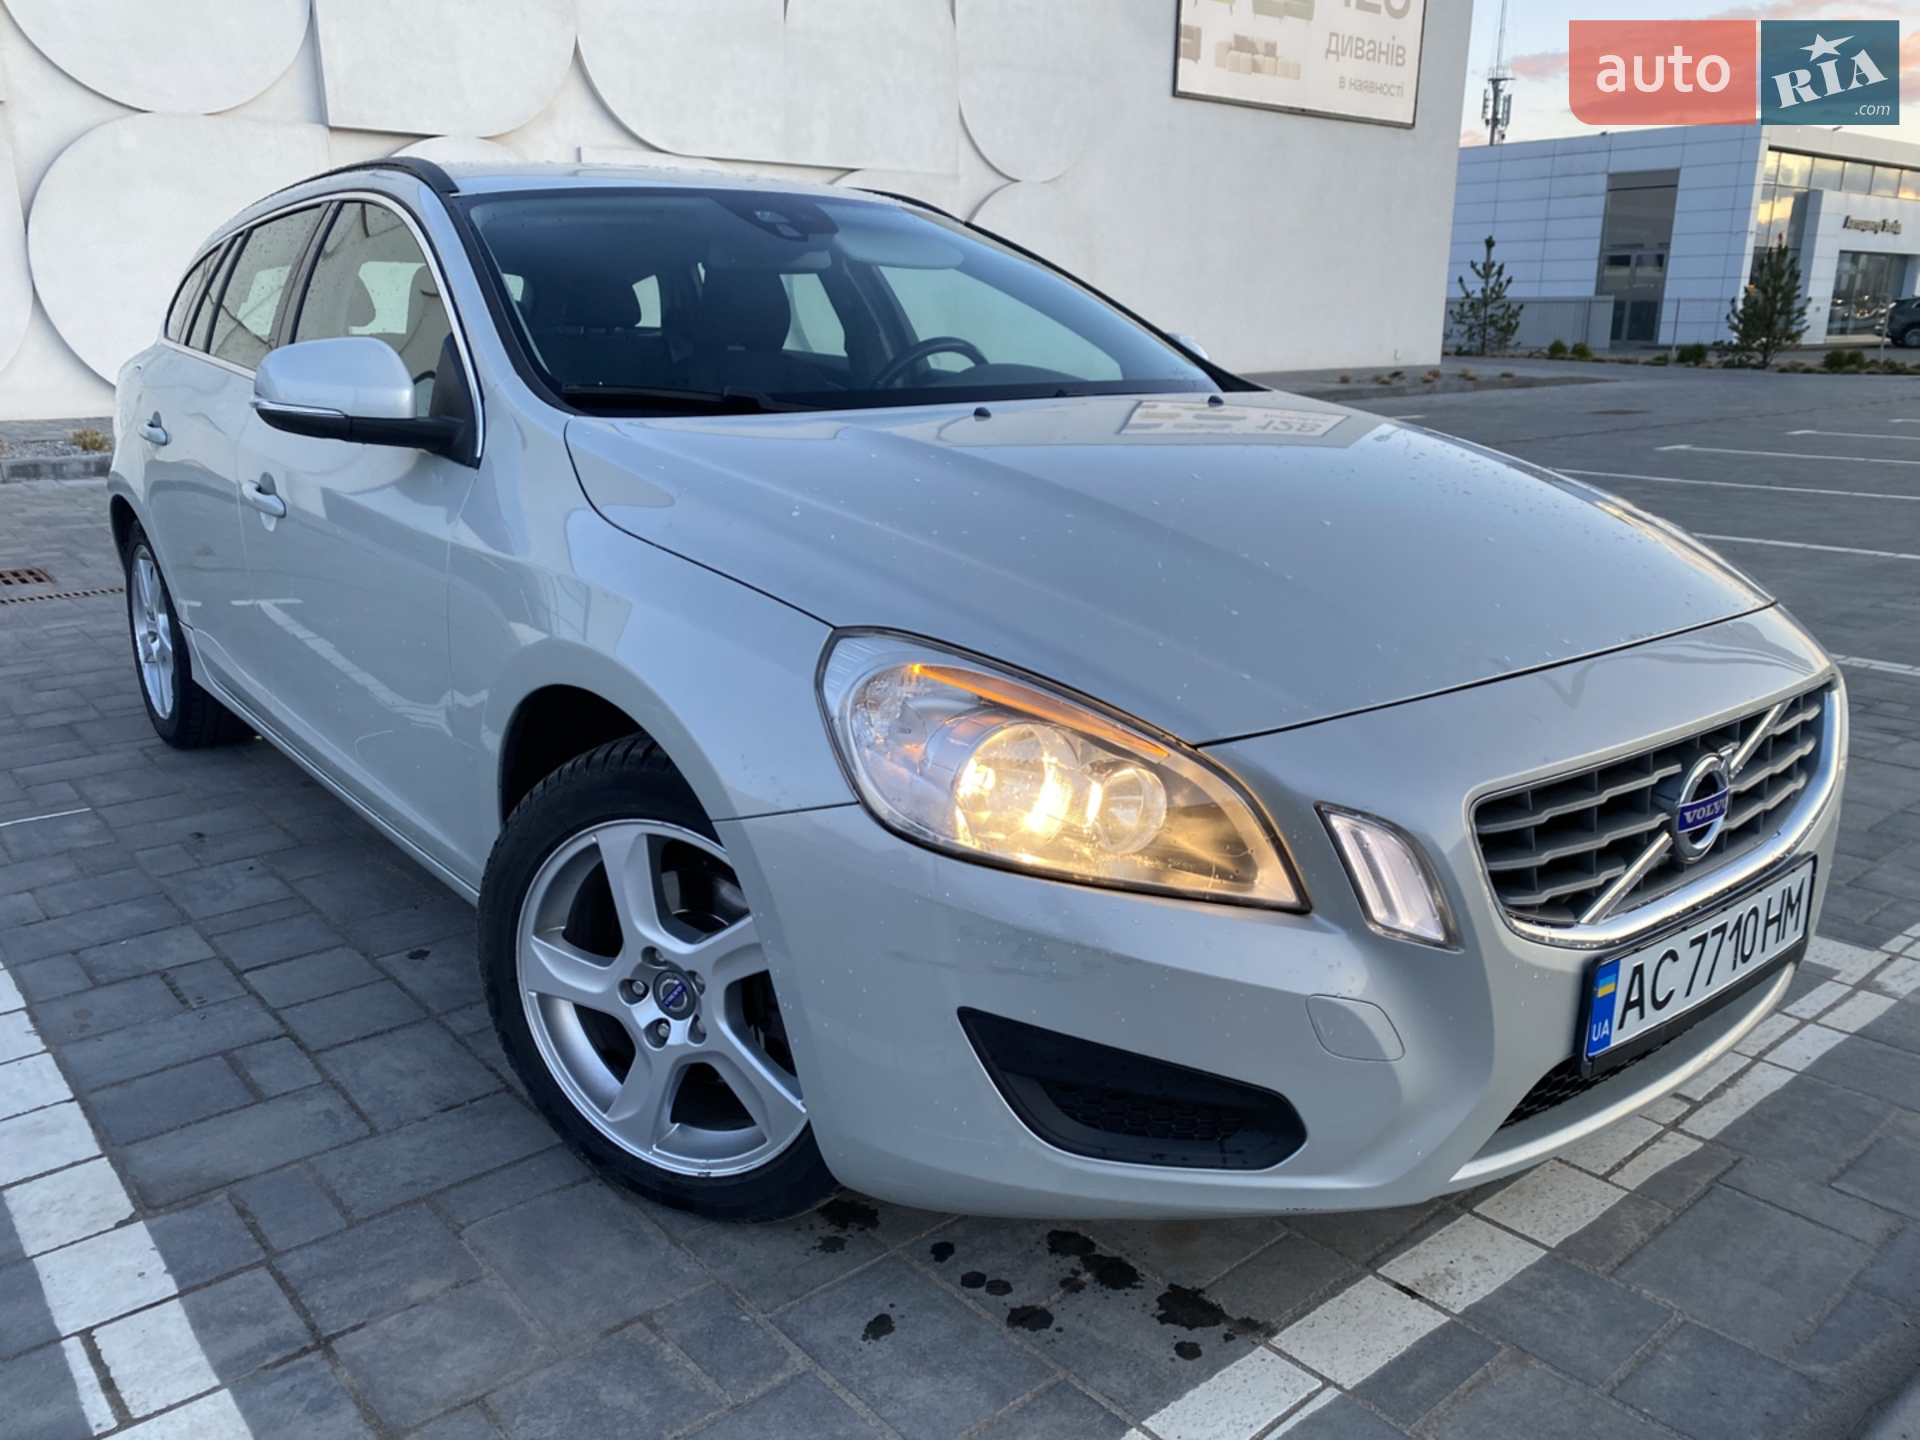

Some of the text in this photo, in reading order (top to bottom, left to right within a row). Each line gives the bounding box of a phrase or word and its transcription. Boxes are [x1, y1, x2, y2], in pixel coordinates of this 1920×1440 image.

[1325, 32, 1407, 68] диванів
[1338, 76, 1405, 99] в наявності
[1617, 873, 1805, 1031] AC 7710 HM
[1592, 1018, 1610, 1042] UA
